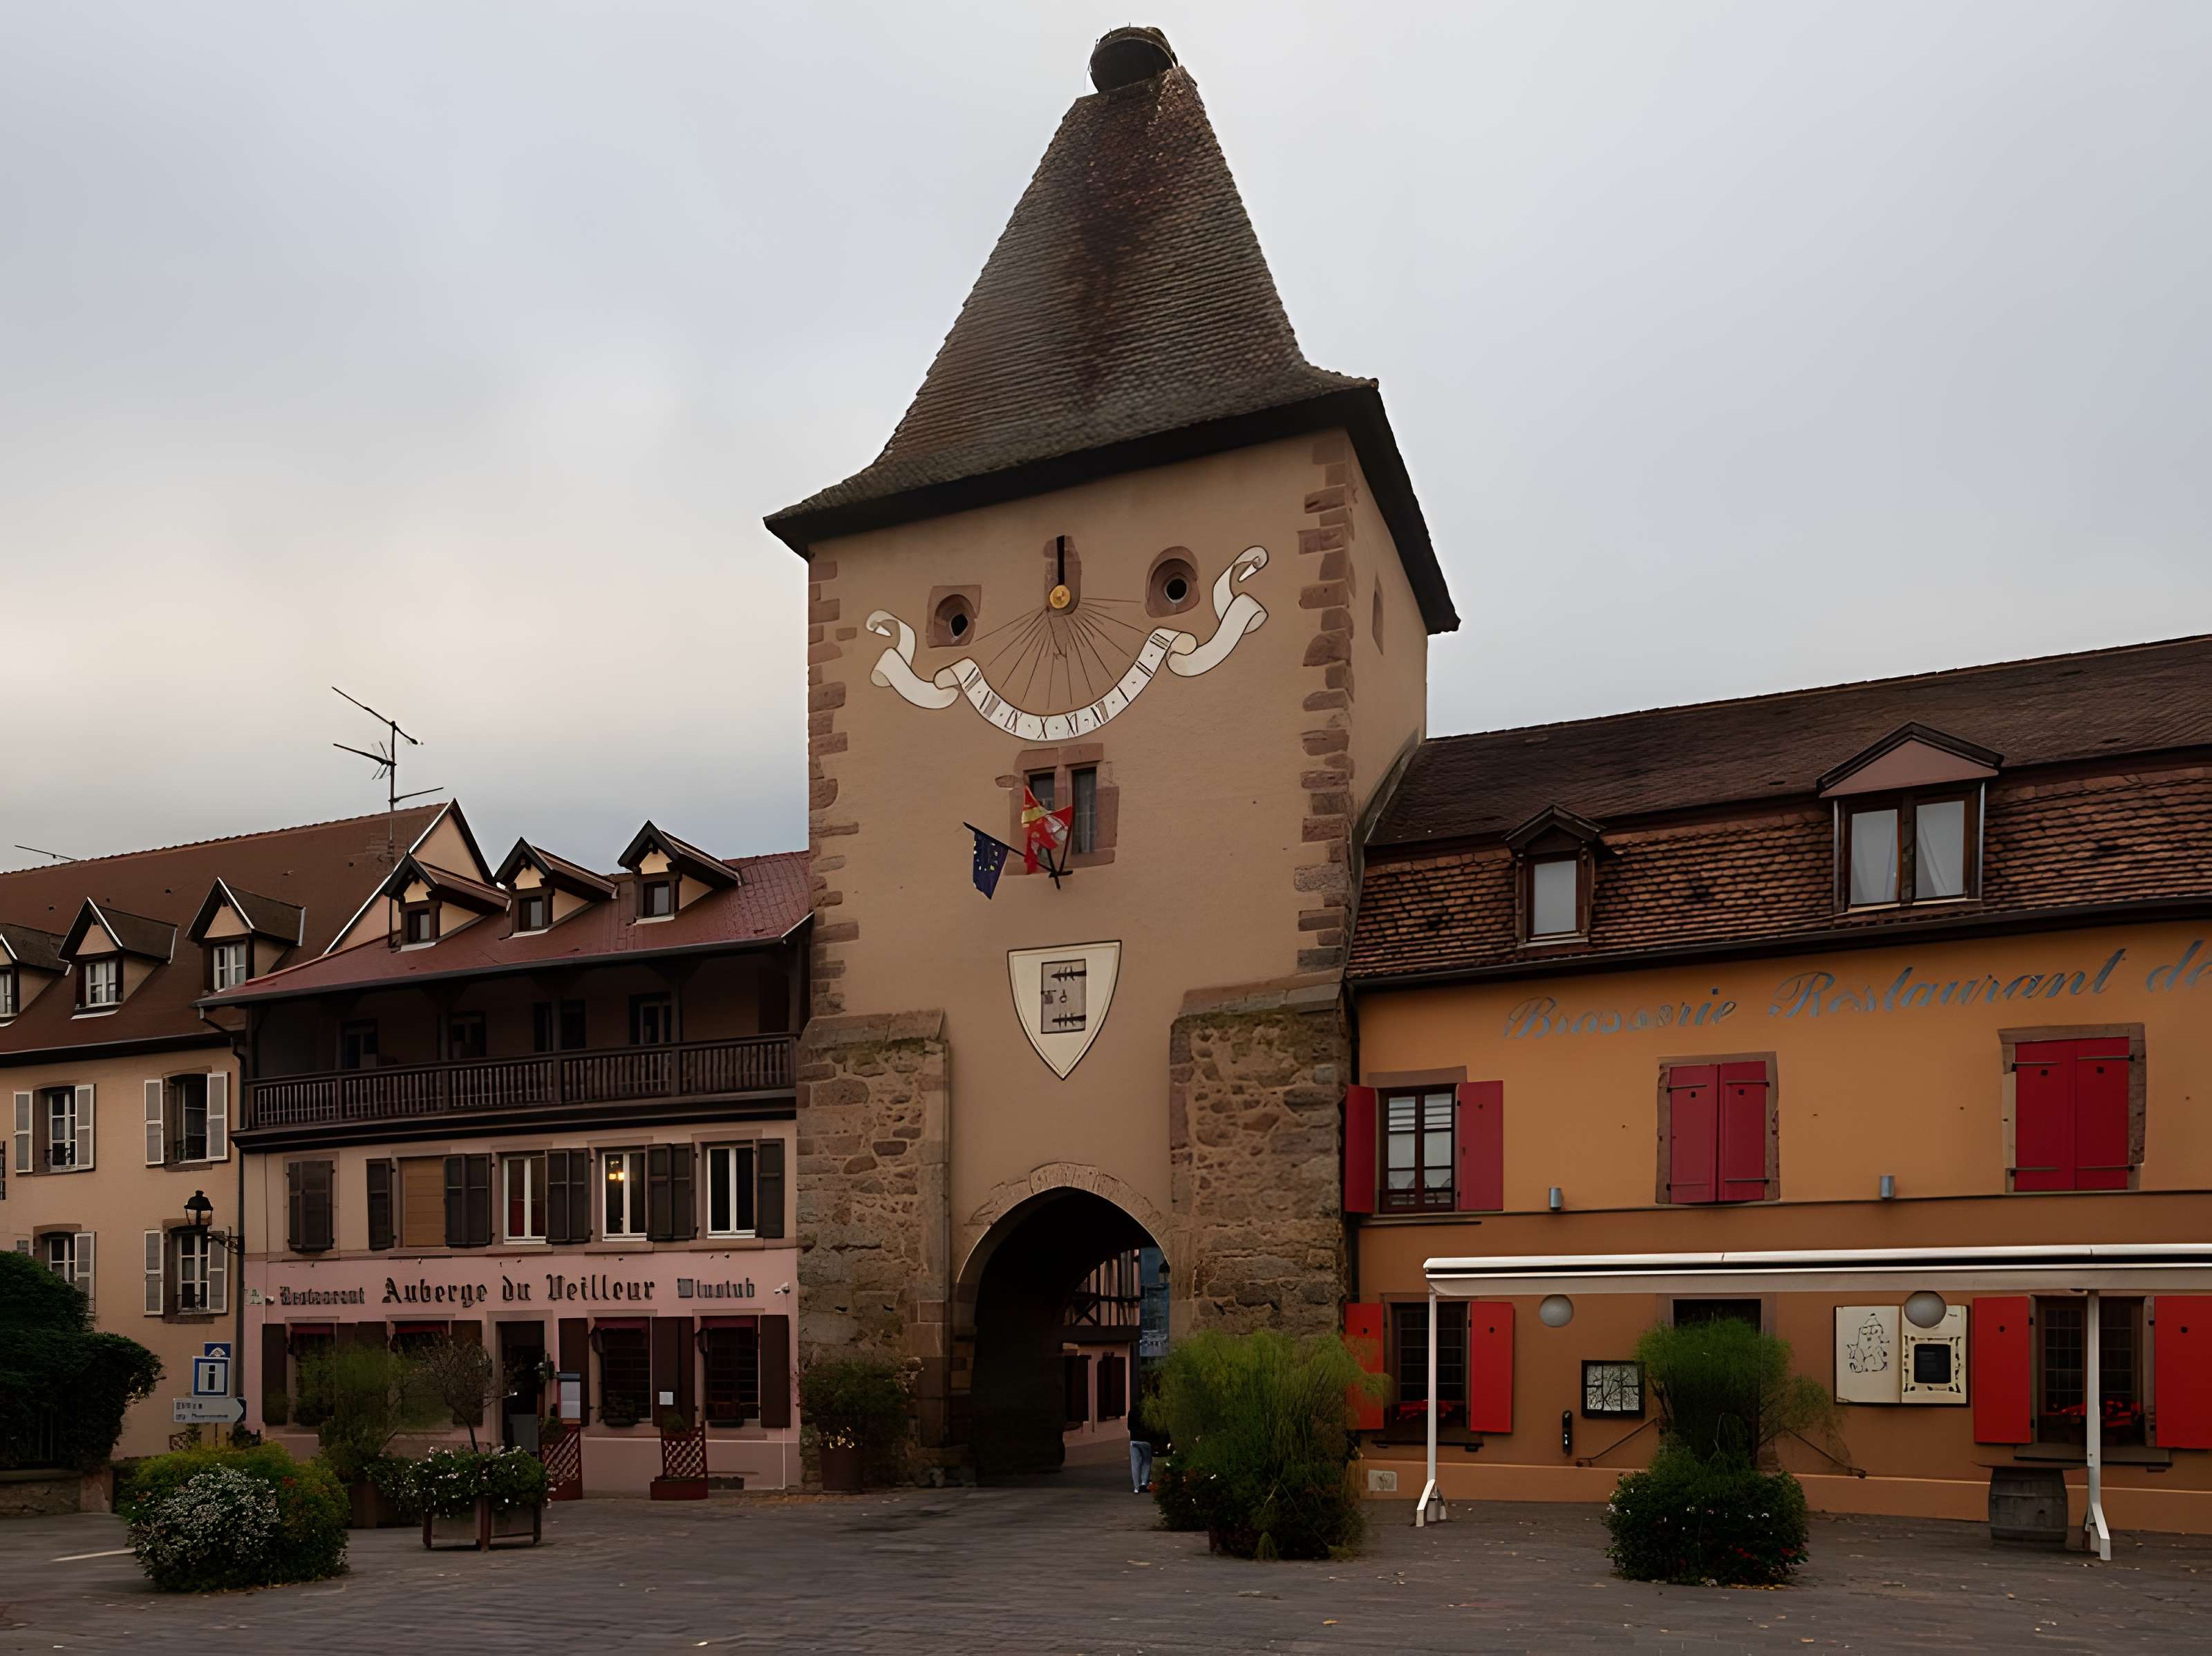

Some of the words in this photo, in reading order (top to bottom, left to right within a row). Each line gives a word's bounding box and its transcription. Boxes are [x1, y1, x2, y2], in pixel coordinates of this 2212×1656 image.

[1768, 948, 2128, 1019] Restaurant
[382, 1277, 488, 1308] Auberge
[502, 1274, 532, 1301] du
[545, 1273, 655, 1301] Veilleur
